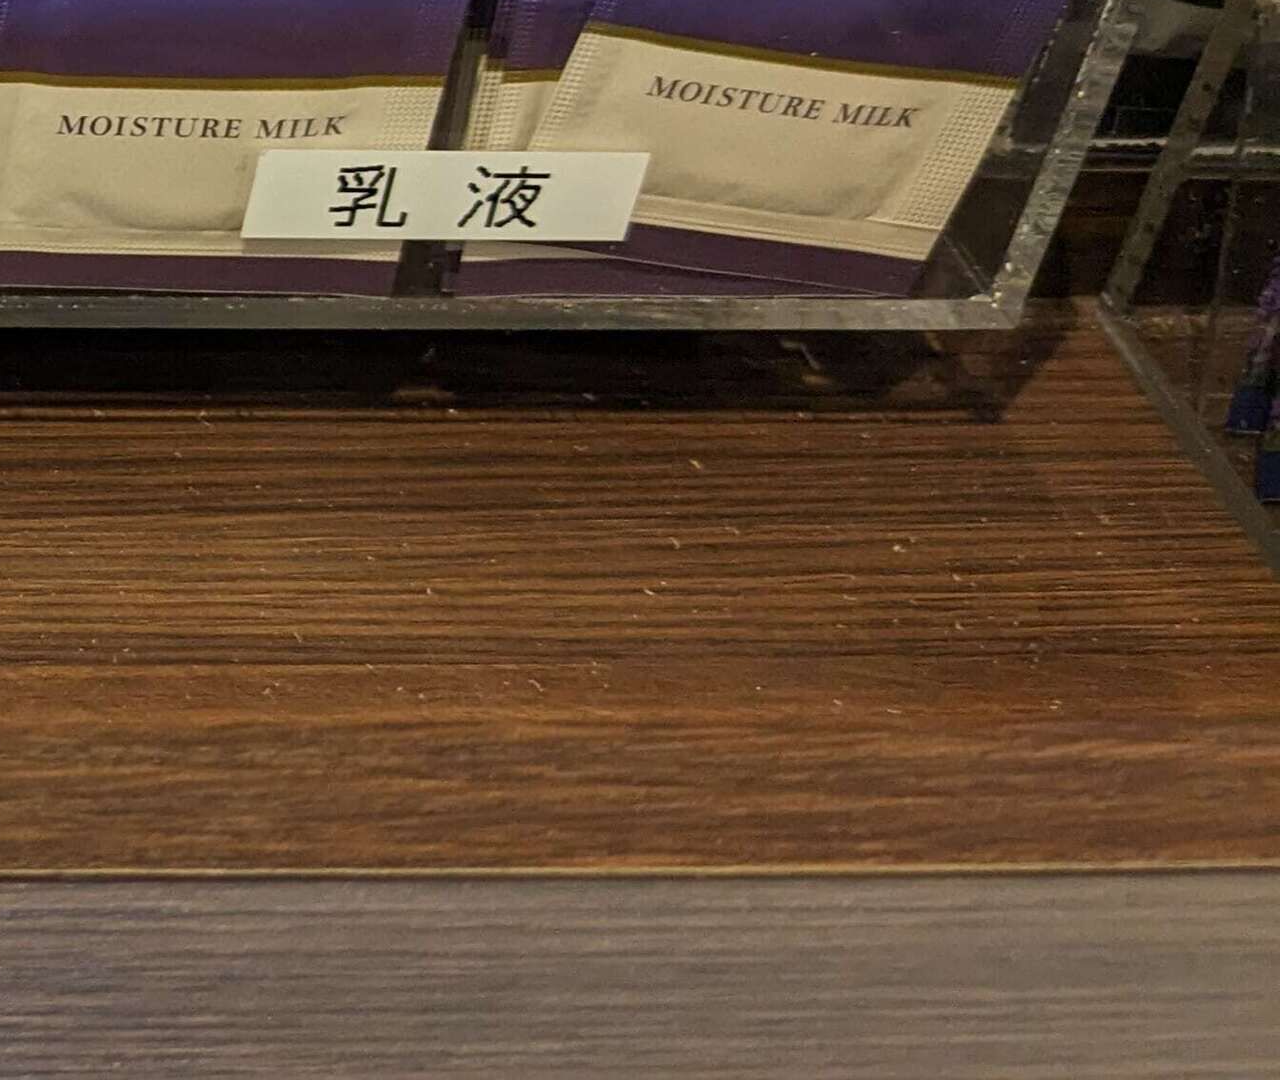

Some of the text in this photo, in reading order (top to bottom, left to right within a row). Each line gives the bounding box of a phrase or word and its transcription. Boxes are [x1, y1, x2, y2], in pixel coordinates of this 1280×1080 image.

[646, 75, 920, 129] MOISTURE MILK
[56, 114, 345, 140] MOISTURE MILK
